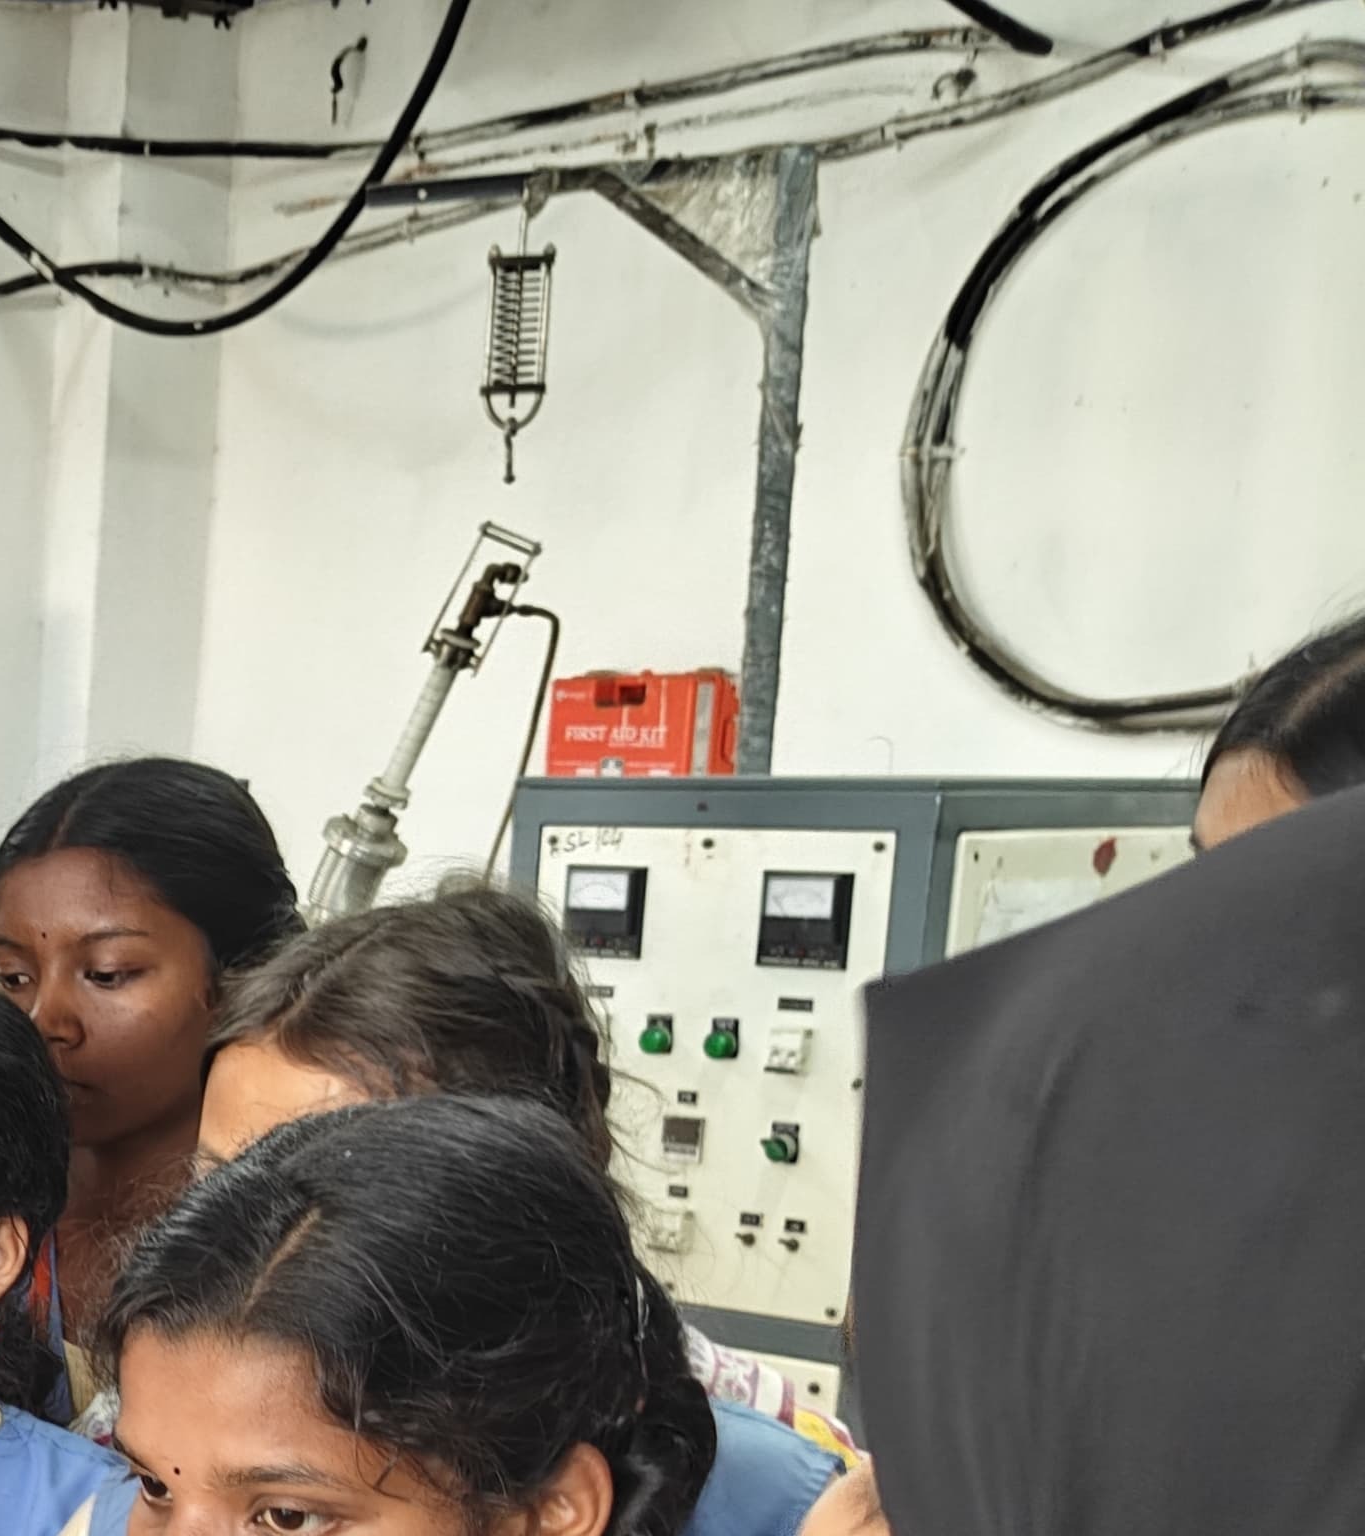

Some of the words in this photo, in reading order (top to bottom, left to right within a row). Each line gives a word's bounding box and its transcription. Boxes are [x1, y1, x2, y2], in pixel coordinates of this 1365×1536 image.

[565, 724, 607, 742] FIRST
[610, 726, 636, 743] AID
[638, 727, 668, 746] KIT
